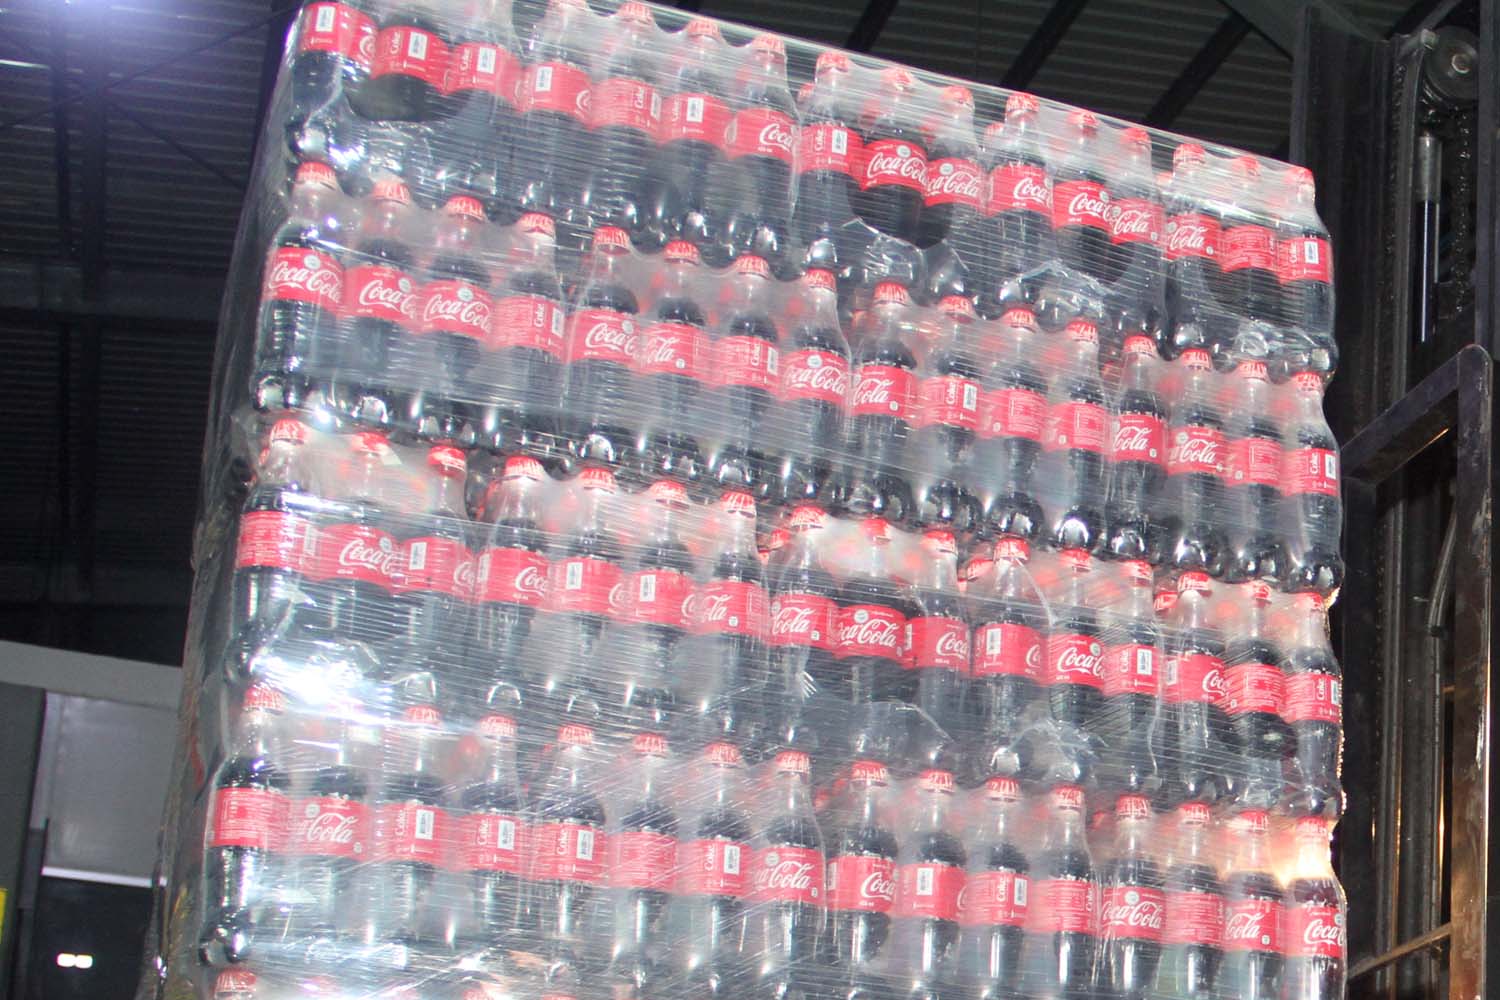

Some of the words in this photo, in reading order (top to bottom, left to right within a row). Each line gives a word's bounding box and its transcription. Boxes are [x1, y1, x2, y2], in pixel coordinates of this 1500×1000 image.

[534, 303, 545, 327] Coke
[946, 382, 956, 405] Coke
[1309, 452, 1319, 474] Coke
[1316, 678, 1325, 700] Coke
[477, 819, 489, 845] Coke
[557, 828, 568, 855] Coke
[704, 845, 715, 871] Coke
